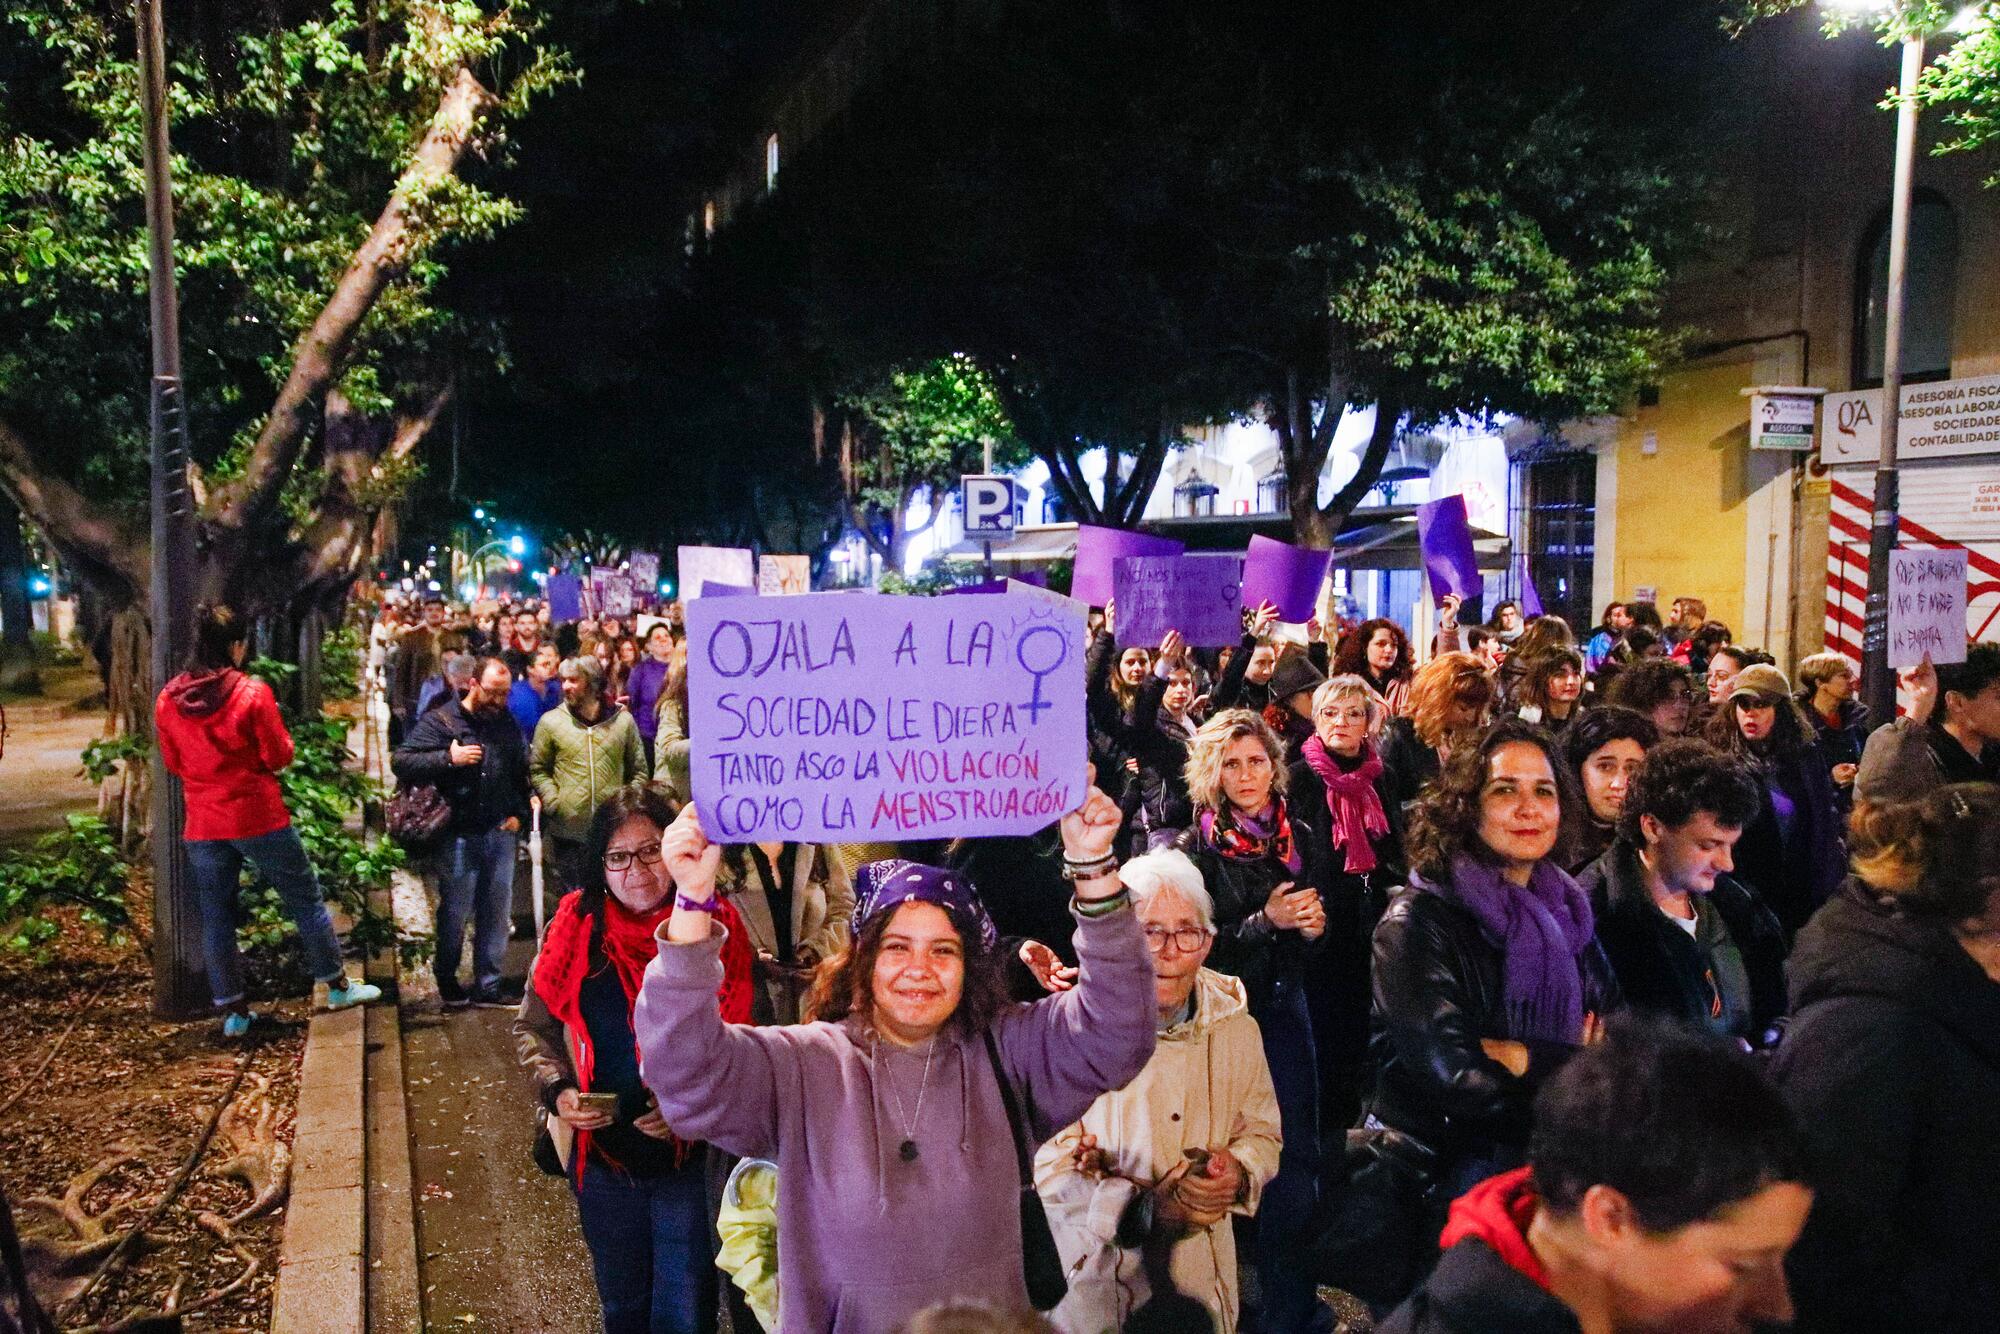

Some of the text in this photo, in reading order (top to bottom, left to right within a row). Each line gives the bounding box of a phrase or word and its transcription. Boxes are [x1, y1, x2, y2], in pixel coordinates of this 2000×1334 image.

[1908, 386, 1965, 404] ASESORÍA
[1909, 431, 2000, 447] CONTABILIDADE
[1933, 416, 2000, 431] SOCIEDADE
[966, 480, 1010, 529] P
[708, 617, 993, 677] OJALA A LA
[717, 693, 1017, 743] SOCIEDAD LE DIERA
[709, 738, 1039, 793] TANTO ASCO LA VIOLACIÓN
[715, 795, 803, 837] COMO
[822, 794, 855, 830] LA
